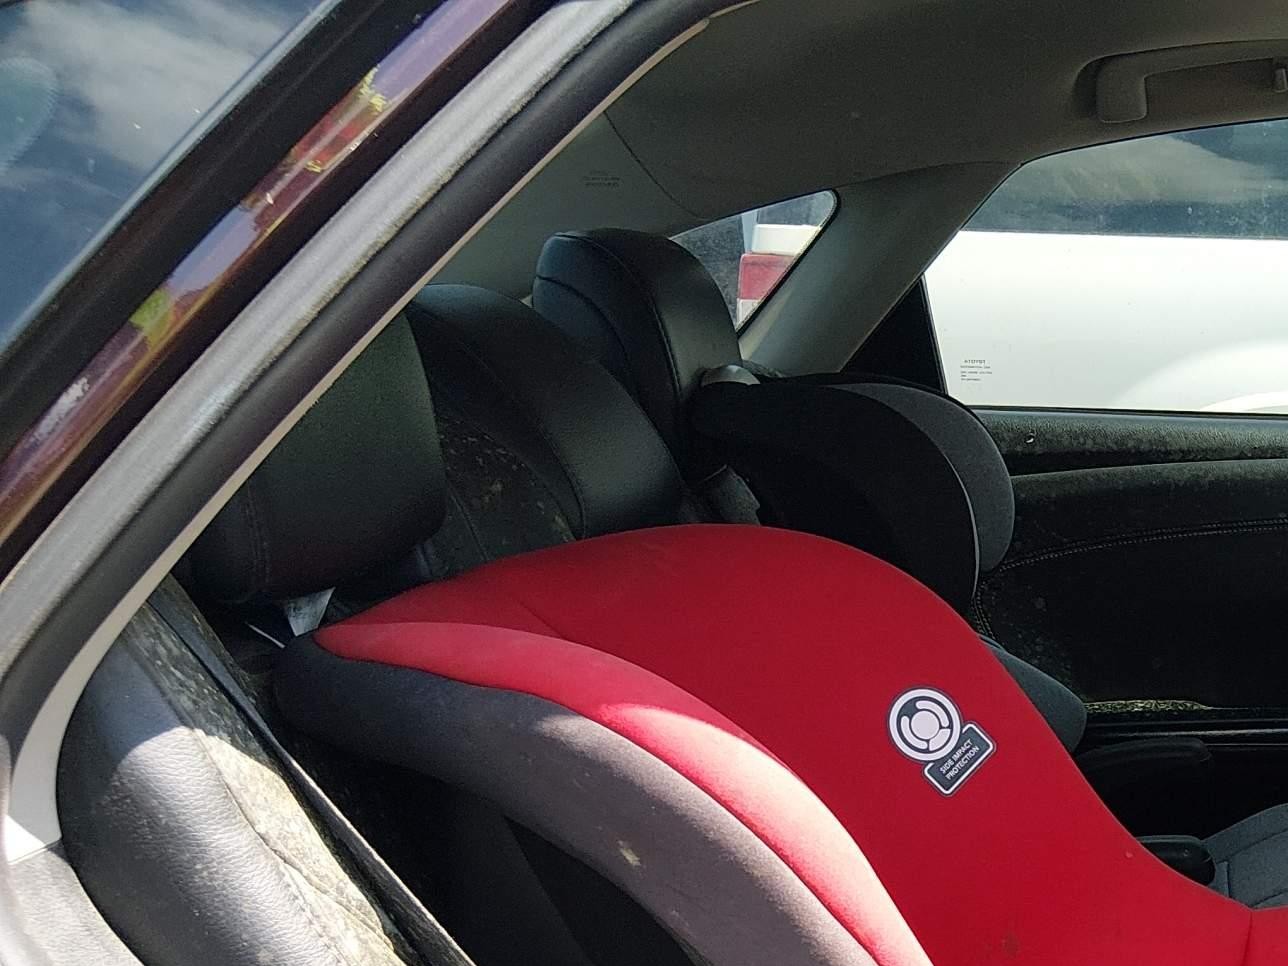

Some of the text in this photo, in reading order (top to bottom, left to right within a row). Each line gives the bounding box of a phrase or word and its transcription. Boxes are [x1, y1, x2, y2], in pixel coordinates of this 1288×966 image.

[940, 738, 973, 774] SIDE IMPACT
[945, 745, 980, 780] PROTECTION
